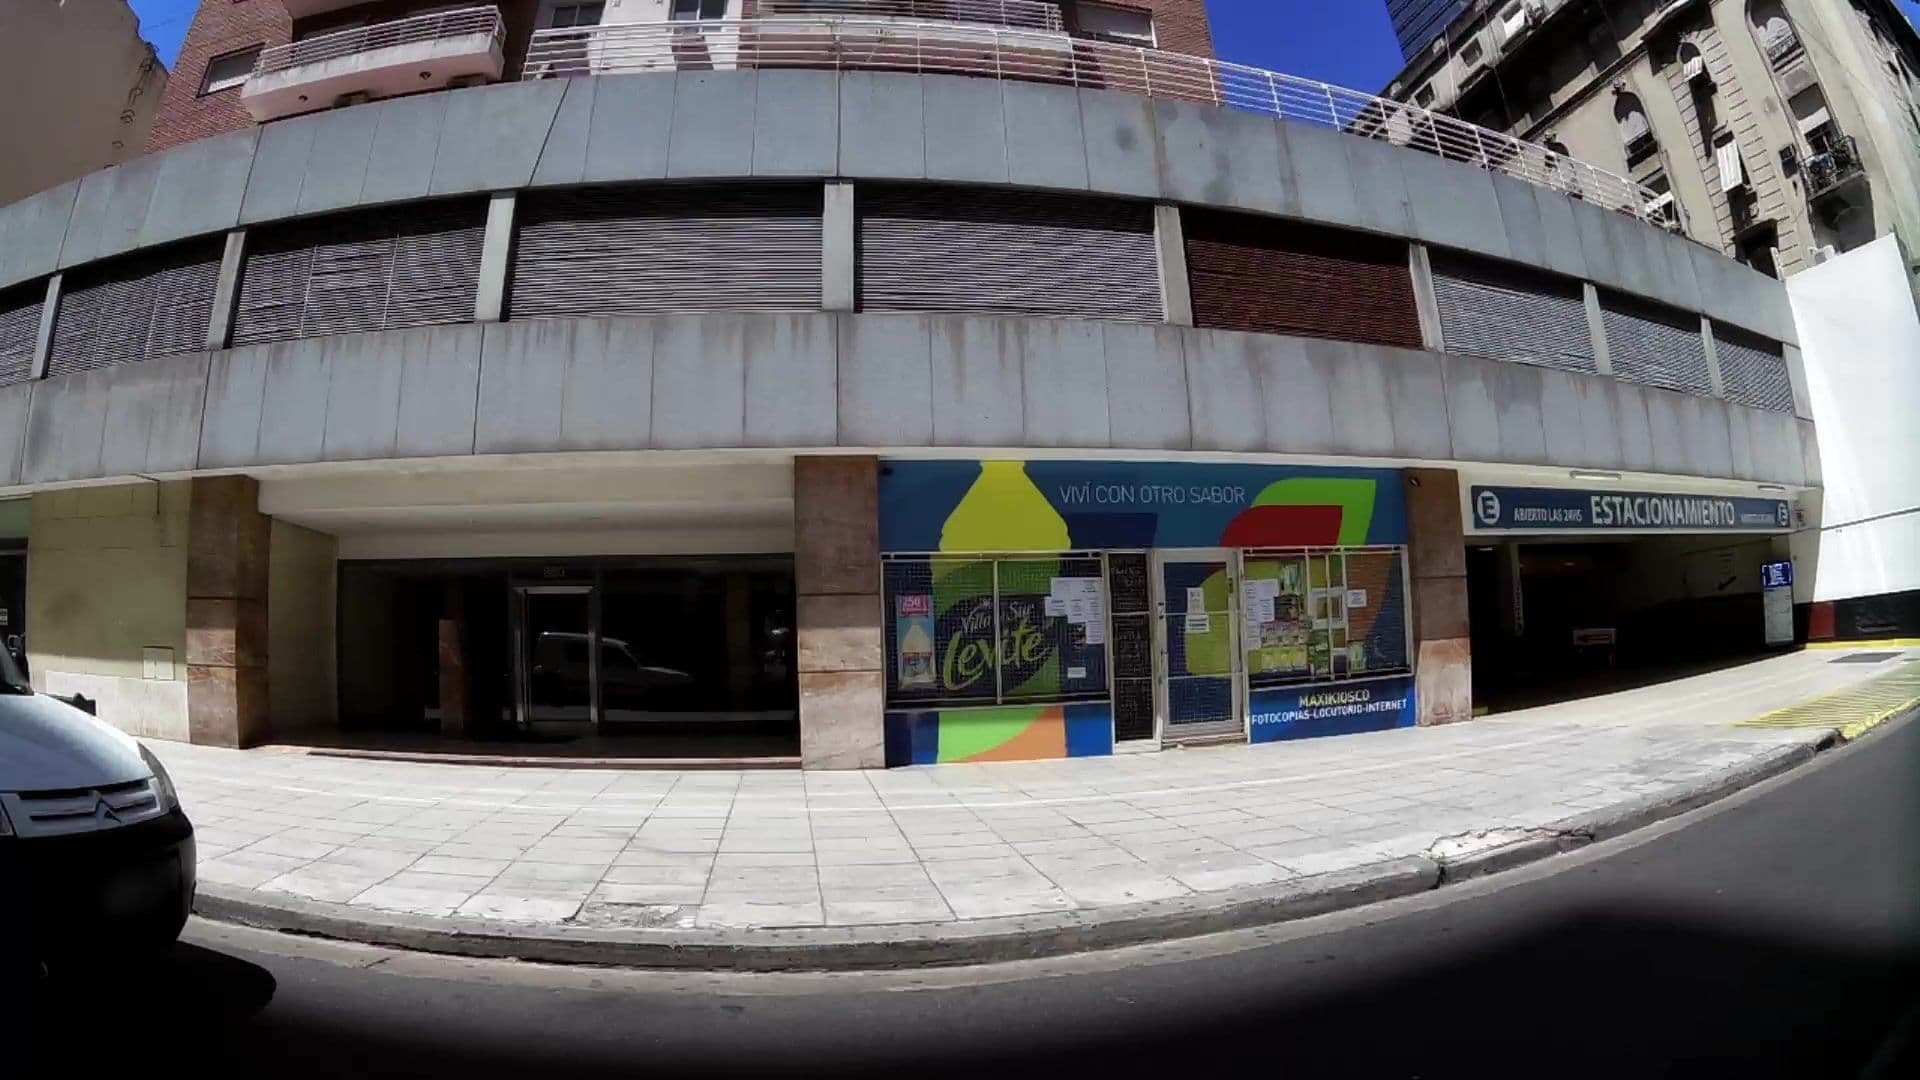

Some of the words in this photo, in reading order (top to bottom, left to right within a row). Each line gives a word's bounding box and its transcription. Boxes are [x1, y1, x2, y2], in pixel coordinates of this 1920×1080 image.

[1060, 481, 1091, 504] VIVÍ
[1095, 485, 1135, 504] CON
[1140, 485, 1186, 504] OTRO
[1190, 486, 1246, 504] SABOR
[1514, 507, 1547, 522] ABIERTO
[1549, 508, 1562, 523] LAS
[1591, 495, 1735, 526] ESTACIONAMIENTO
[1298, 689, 1370, 708] MAXIKIOSCO
